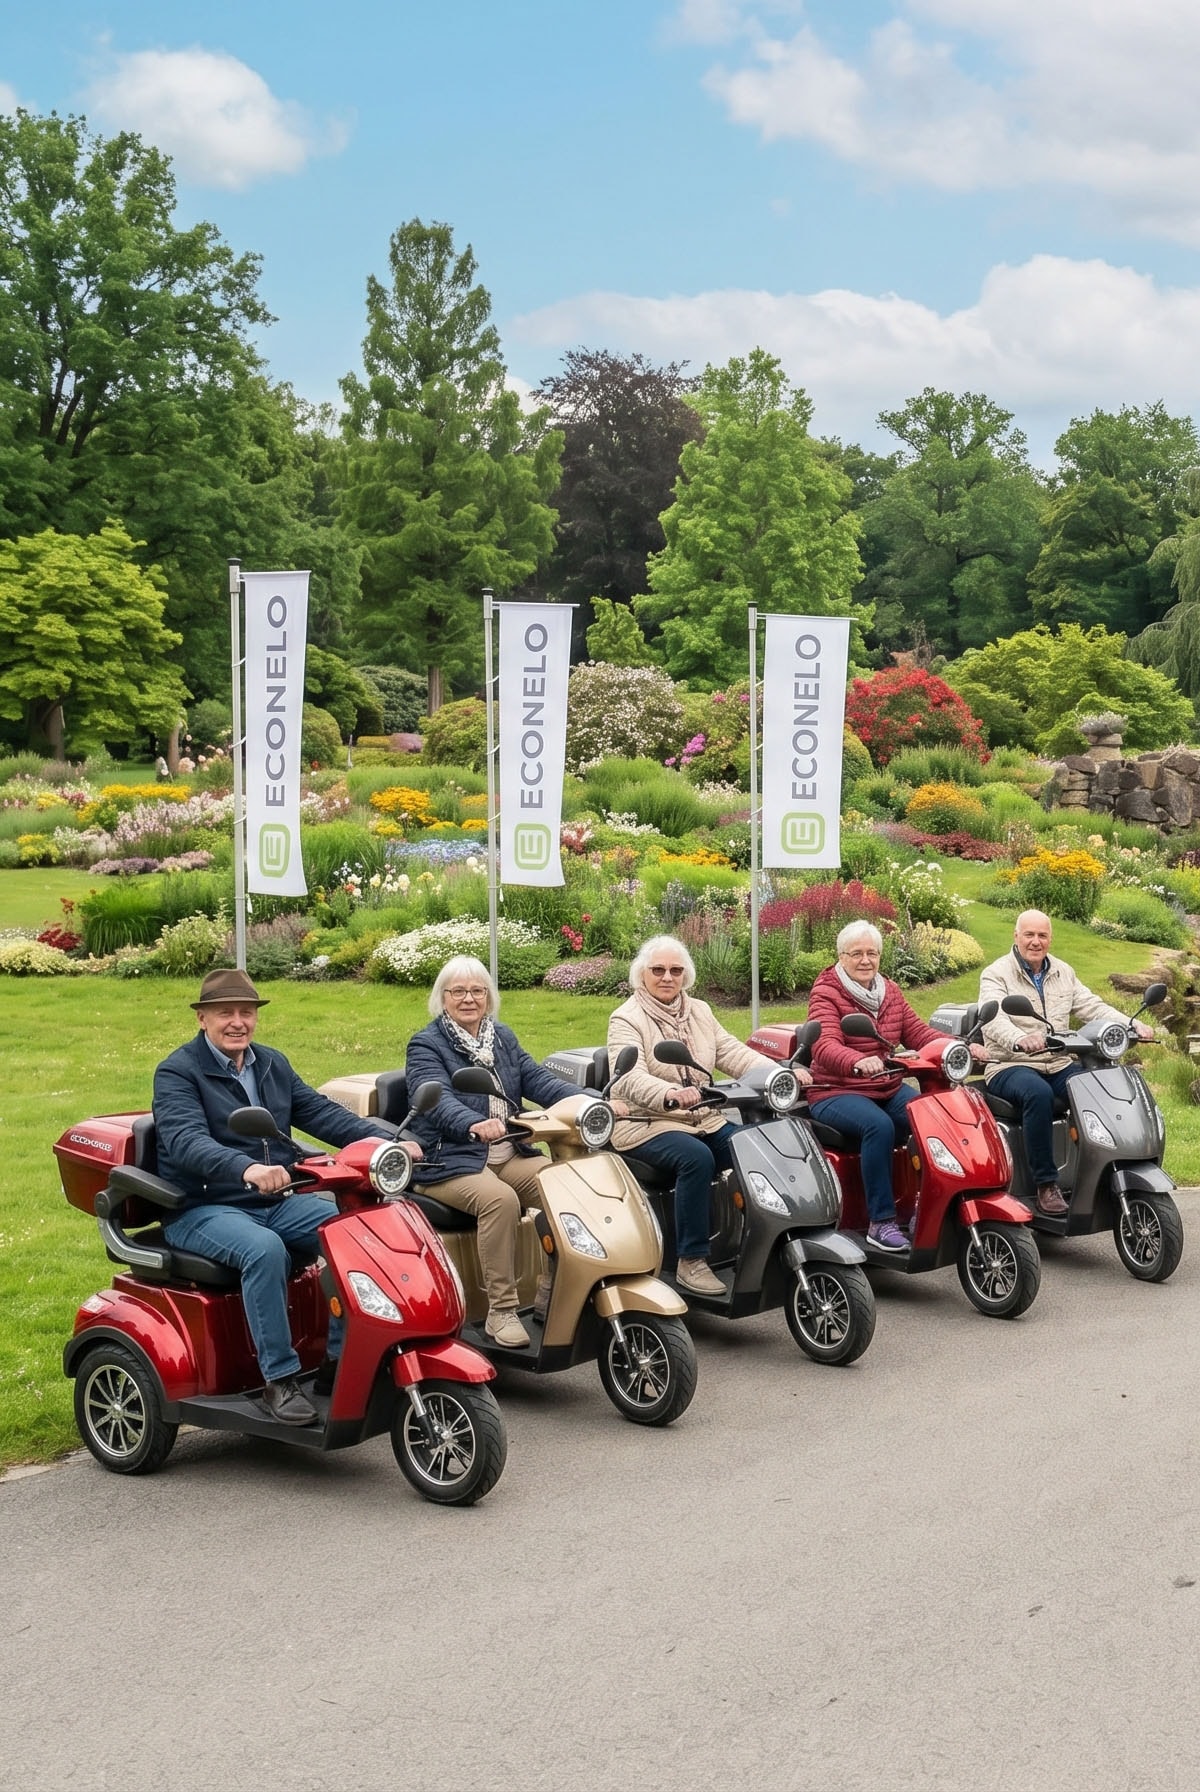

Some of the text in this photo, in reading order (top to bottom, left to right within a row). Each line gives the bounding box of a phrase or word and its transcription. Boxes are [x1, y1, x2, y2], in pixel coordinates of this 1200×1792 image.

[265, 594, 288, 807] ECONELO
[520, 622, 549, 810] ECONELO
[791, 633, 822, 801] ECONELO
